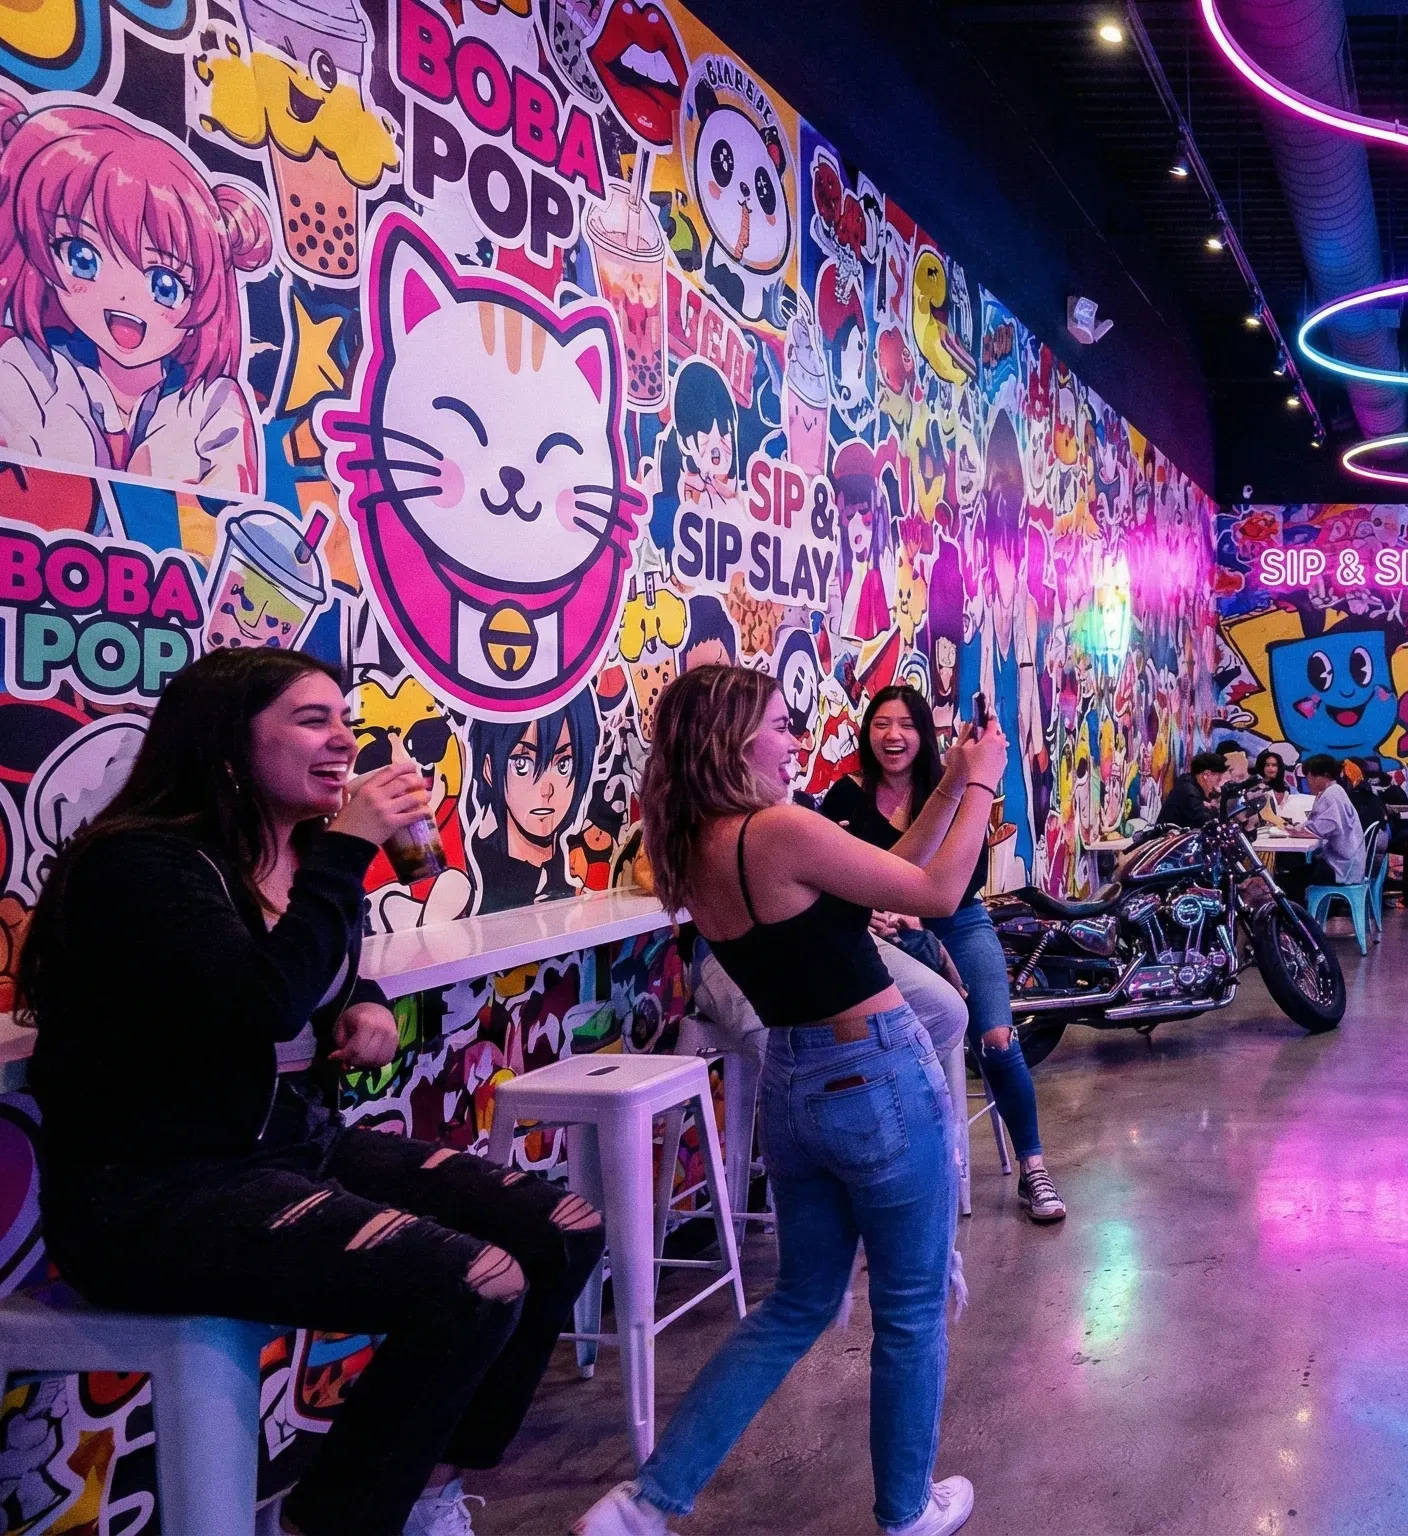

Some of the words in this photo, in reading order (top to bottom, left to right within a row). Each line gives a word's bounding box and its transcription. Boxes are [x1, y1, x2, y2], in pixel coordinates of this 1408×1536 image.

[400, 1, 605, 200] BOBA
[412, 101, 574, 258] POP
[749, 460, 805, 528] SIP
[811, 482, 834, 541] &
[0, 535, 200, 622] BOBA
[677, 511, 743, 583] SIP
[749, 531, 834, 603] SLAY
[1259, 548, 1326, 586] SIP
[1335, 548, 1366, 586] &
[22, 612, 189, 691] POP
